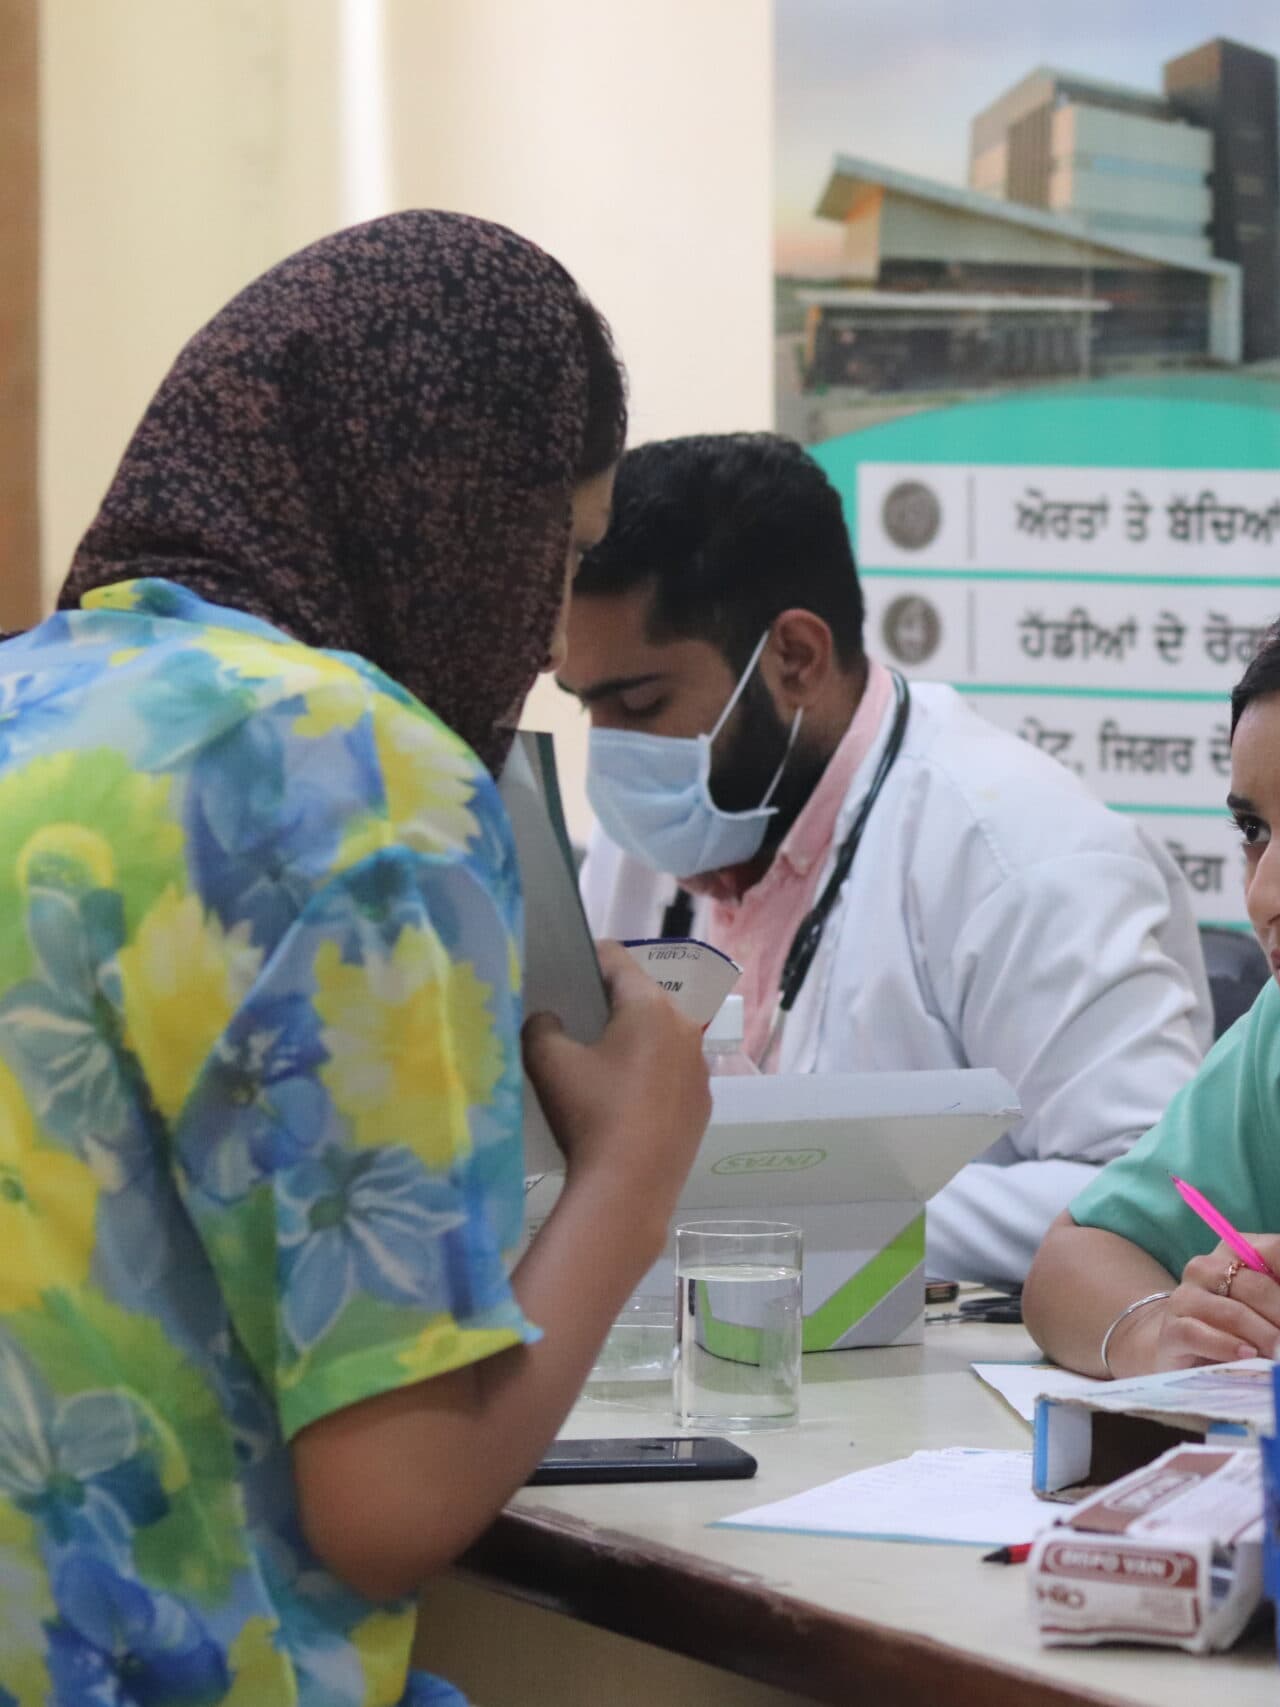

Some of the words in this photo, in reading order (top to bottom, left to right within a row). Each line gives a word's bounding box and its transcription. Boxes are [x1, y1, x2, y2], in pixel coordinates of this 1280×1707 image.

[1122, 489, 1155, 543] ਤੇ
[1018, 606, 1139, 662] ਹੱਡੀਆਂ
[1153, 611, 1188, 665] ਦੇ
[1097, 719, 1196, 776] ਜਿਗਰ
[647, 950, 687, 961] CADILA
